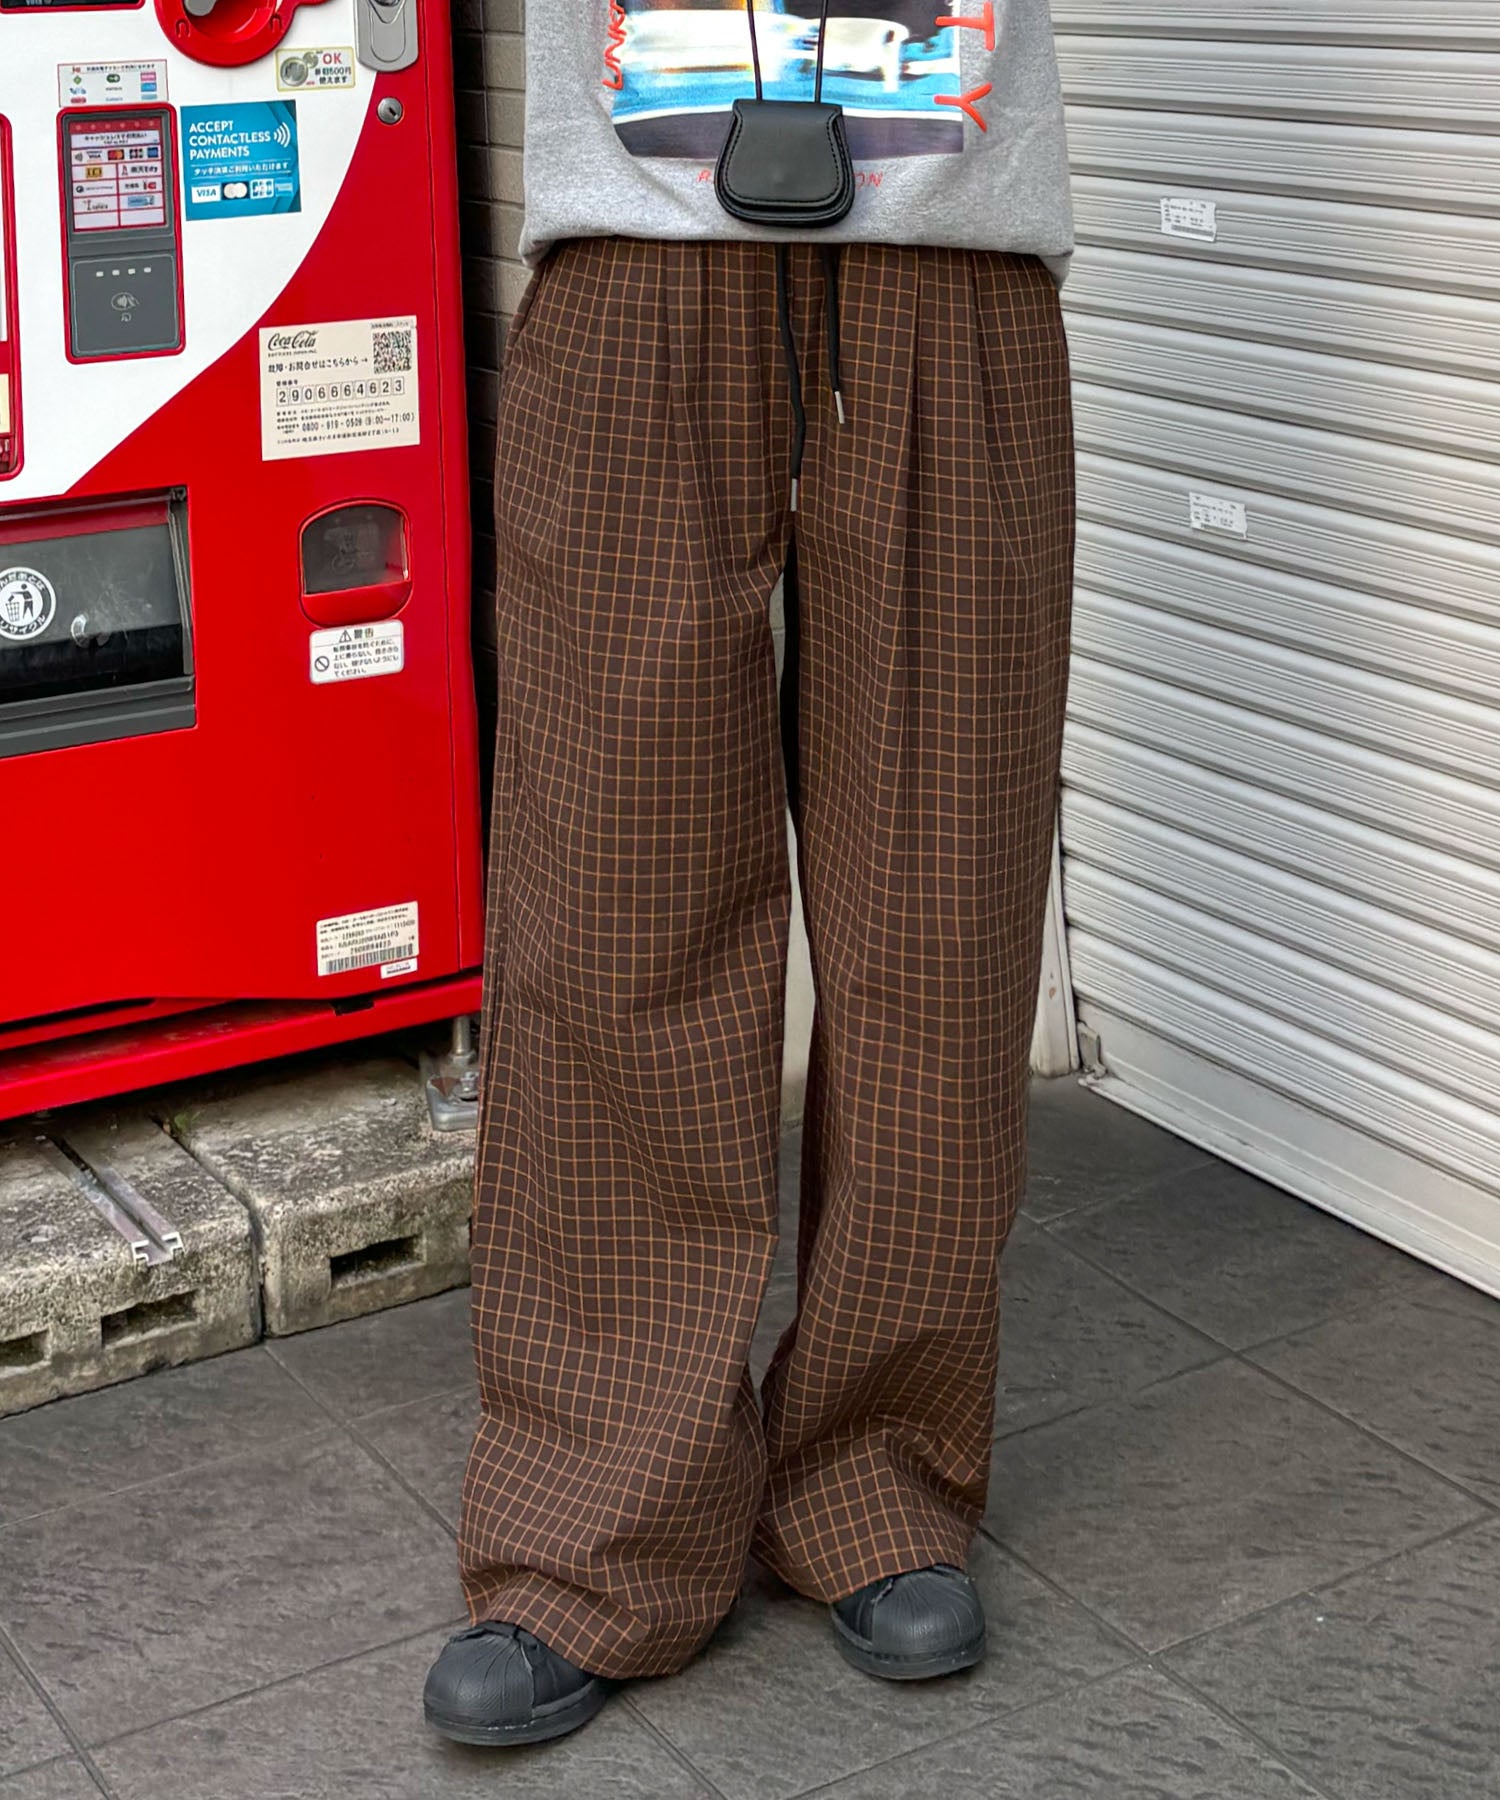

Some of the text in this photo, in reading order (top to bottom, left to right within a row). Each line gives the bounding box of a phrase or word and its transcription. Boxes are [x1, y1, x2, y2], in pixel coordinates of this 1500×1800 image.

[322, 52, 342, 65] OK
[189, 120, 234, 133] ACCEPT
[189, 131, 271, 147] CONTACTLESS
[189, 145, 250, 160] PAYMENTS
[197, 188, 217, 198] VISA
